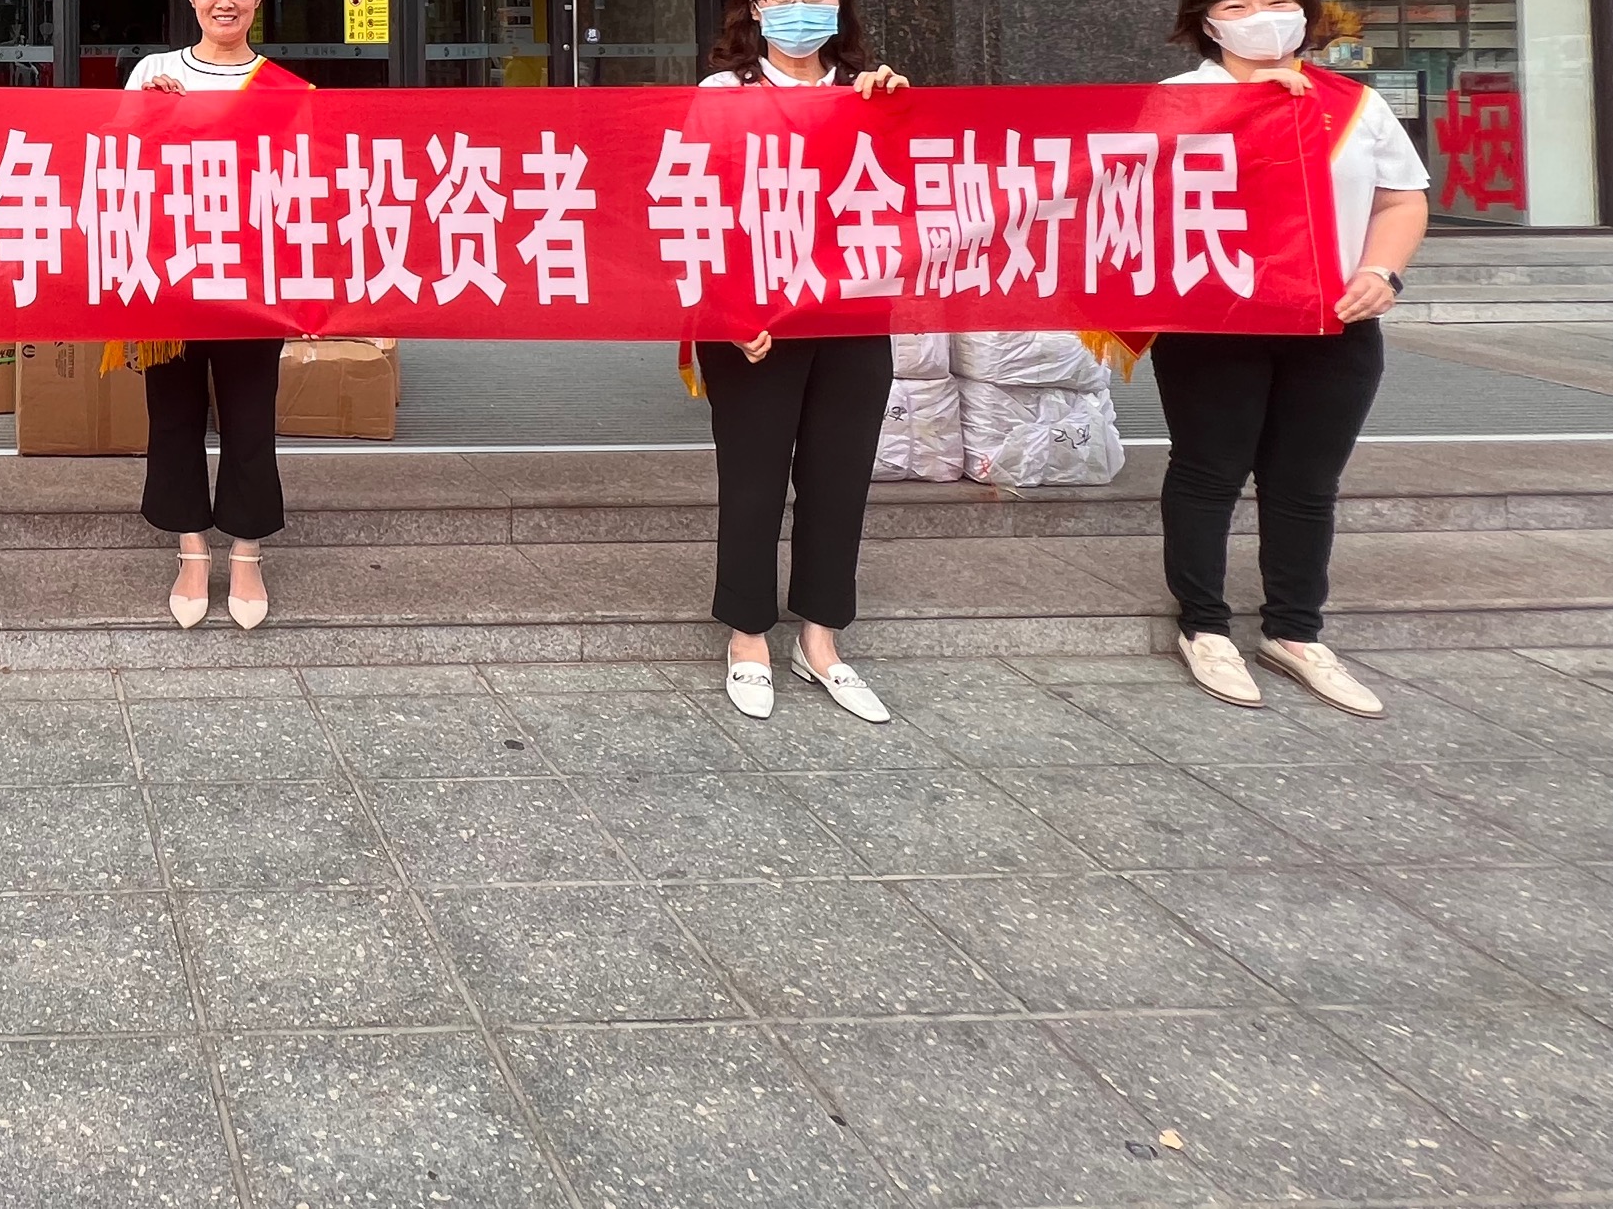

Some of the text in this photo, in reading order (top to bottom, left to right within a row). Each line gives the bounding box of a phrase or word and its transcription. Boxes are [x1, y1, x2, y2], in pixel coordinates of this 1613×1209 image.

[645, 127, 1256, 307] 争做金融好网民
[1434, 89, 1528, 212] 烟
